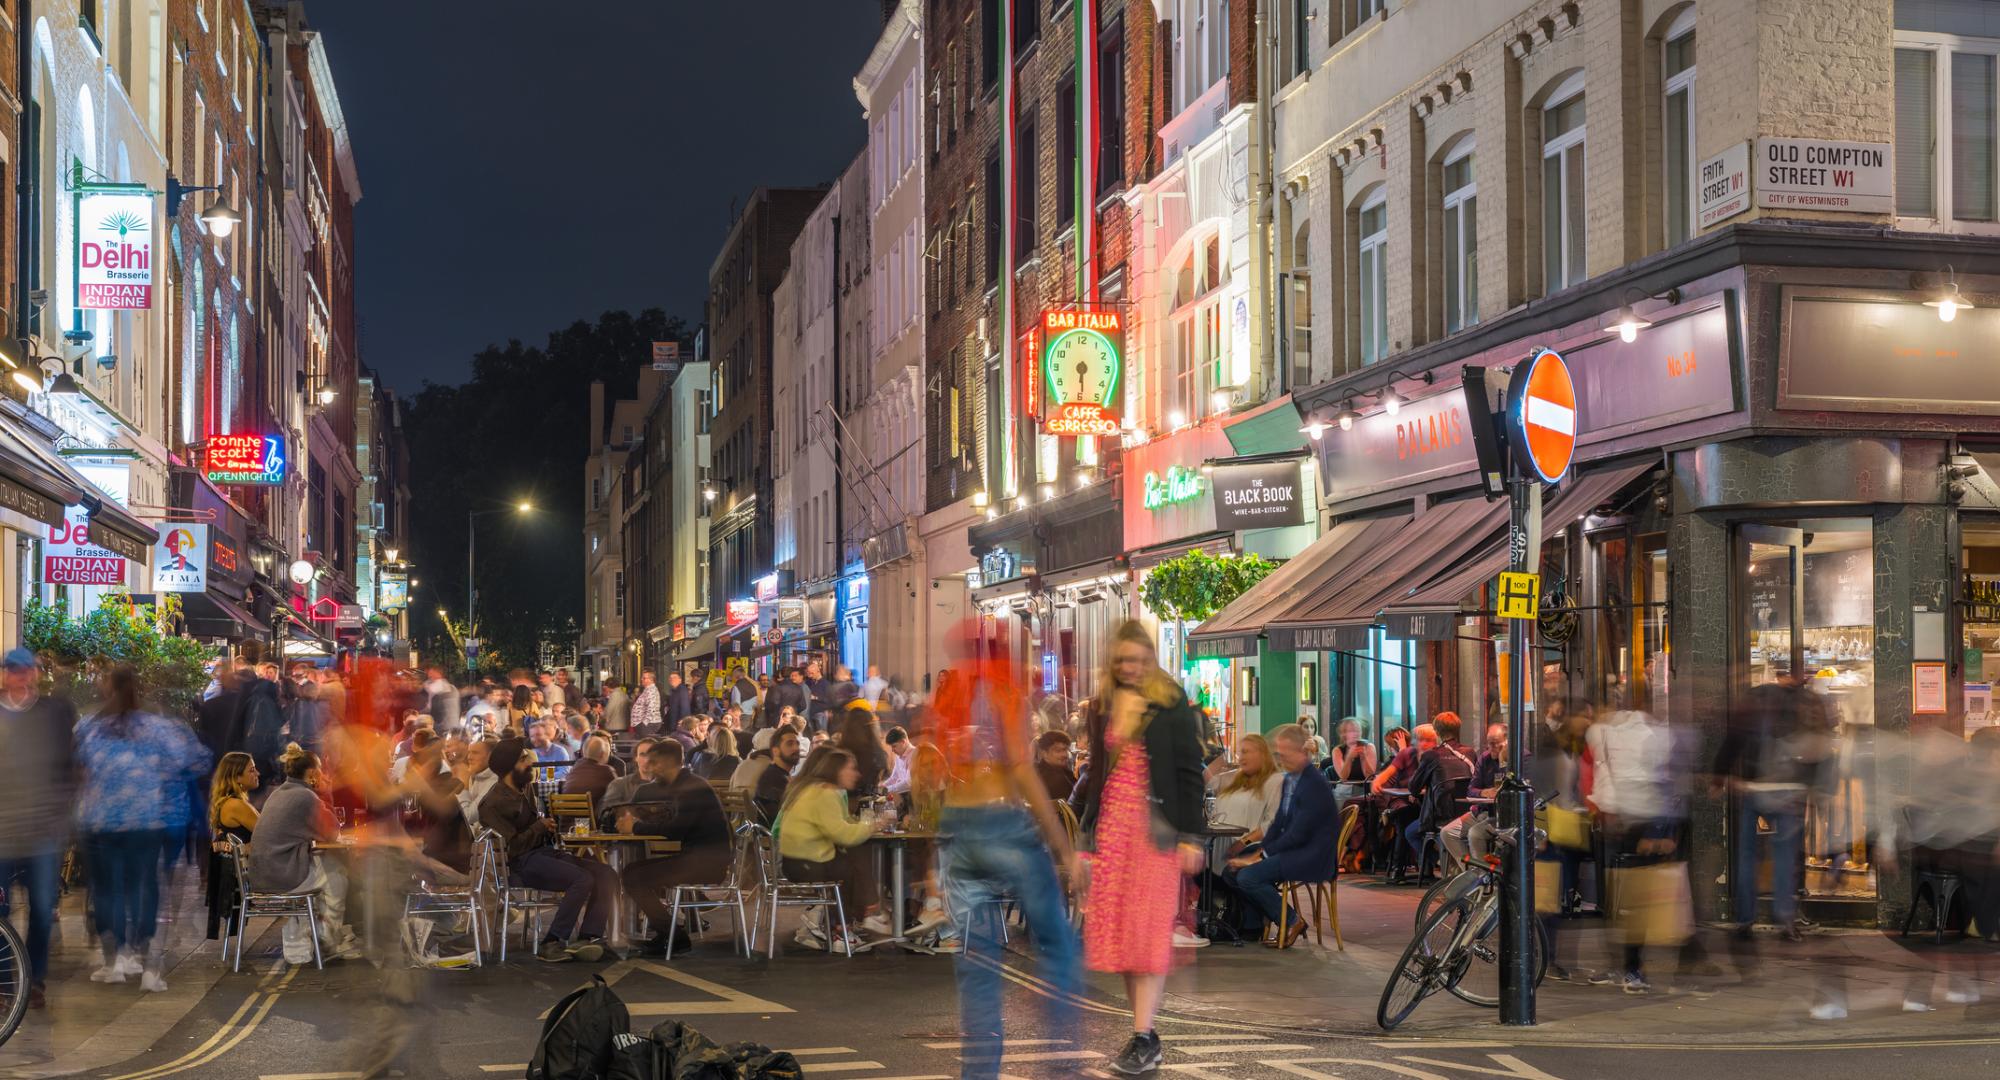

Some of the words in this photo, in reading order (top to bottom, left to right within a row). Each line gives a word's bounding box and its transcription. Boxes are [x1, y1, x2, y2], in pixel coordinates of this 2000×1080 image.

[1768, 144, 1799, 163] OLD
[1806, 146, 1883, 168] COMPTON
[1703, 158, 1724, 184] FRITH
[1768, 166, 1828, 186] STREET
[1833, 169, 1854, 188] W1
[1703, 177, 1730, 204] STREET
[1731, 171, 1744, 191] W1
[1768, 193, 1785, 204] CITY
[1787, 194, 1798, 204] OF
[1798, 194, 1849, 207] WESTMINSTER
[106, 240, 118, 248] The
[82, 242, 149, 269] Delhi
[106, 270, 149, 279] Brasserie
[85, 285, 145, 297] INDIAN
[86, 296, 145, 307] CUISINE
[1048, 313, 1075, 328] BAR
[1077, 313, 1118, 329] ITALIA
[1047, 420, 1117, 432] ESPRESSO
[1396, 407, 1462, 461] BALANS
[210, 436, 261, 447] ronnie
[210, 447, 260, 458] scott's
[1145, 471, 1163, 509] Bar
[1167, 465, 1199, 503] Italia
[1252, 480, 1263, 488] THE
[1224, 489, 1261, 505] BLACK
[1263, 486, 1293, 502] BOOK
[1518, 532, 1527, 546] S
[1518, 549, 1526, 562] 7
[52, 558, 118, 571] INDIAN
[52, 570, 118, 582] CUISINE
[159, 573, 201, 583] ZIMA
[1410, 616, 1426, 635] CAFE
[770, 632, 780, 640] 20
[1302, 629, 1313, 648] DAY
